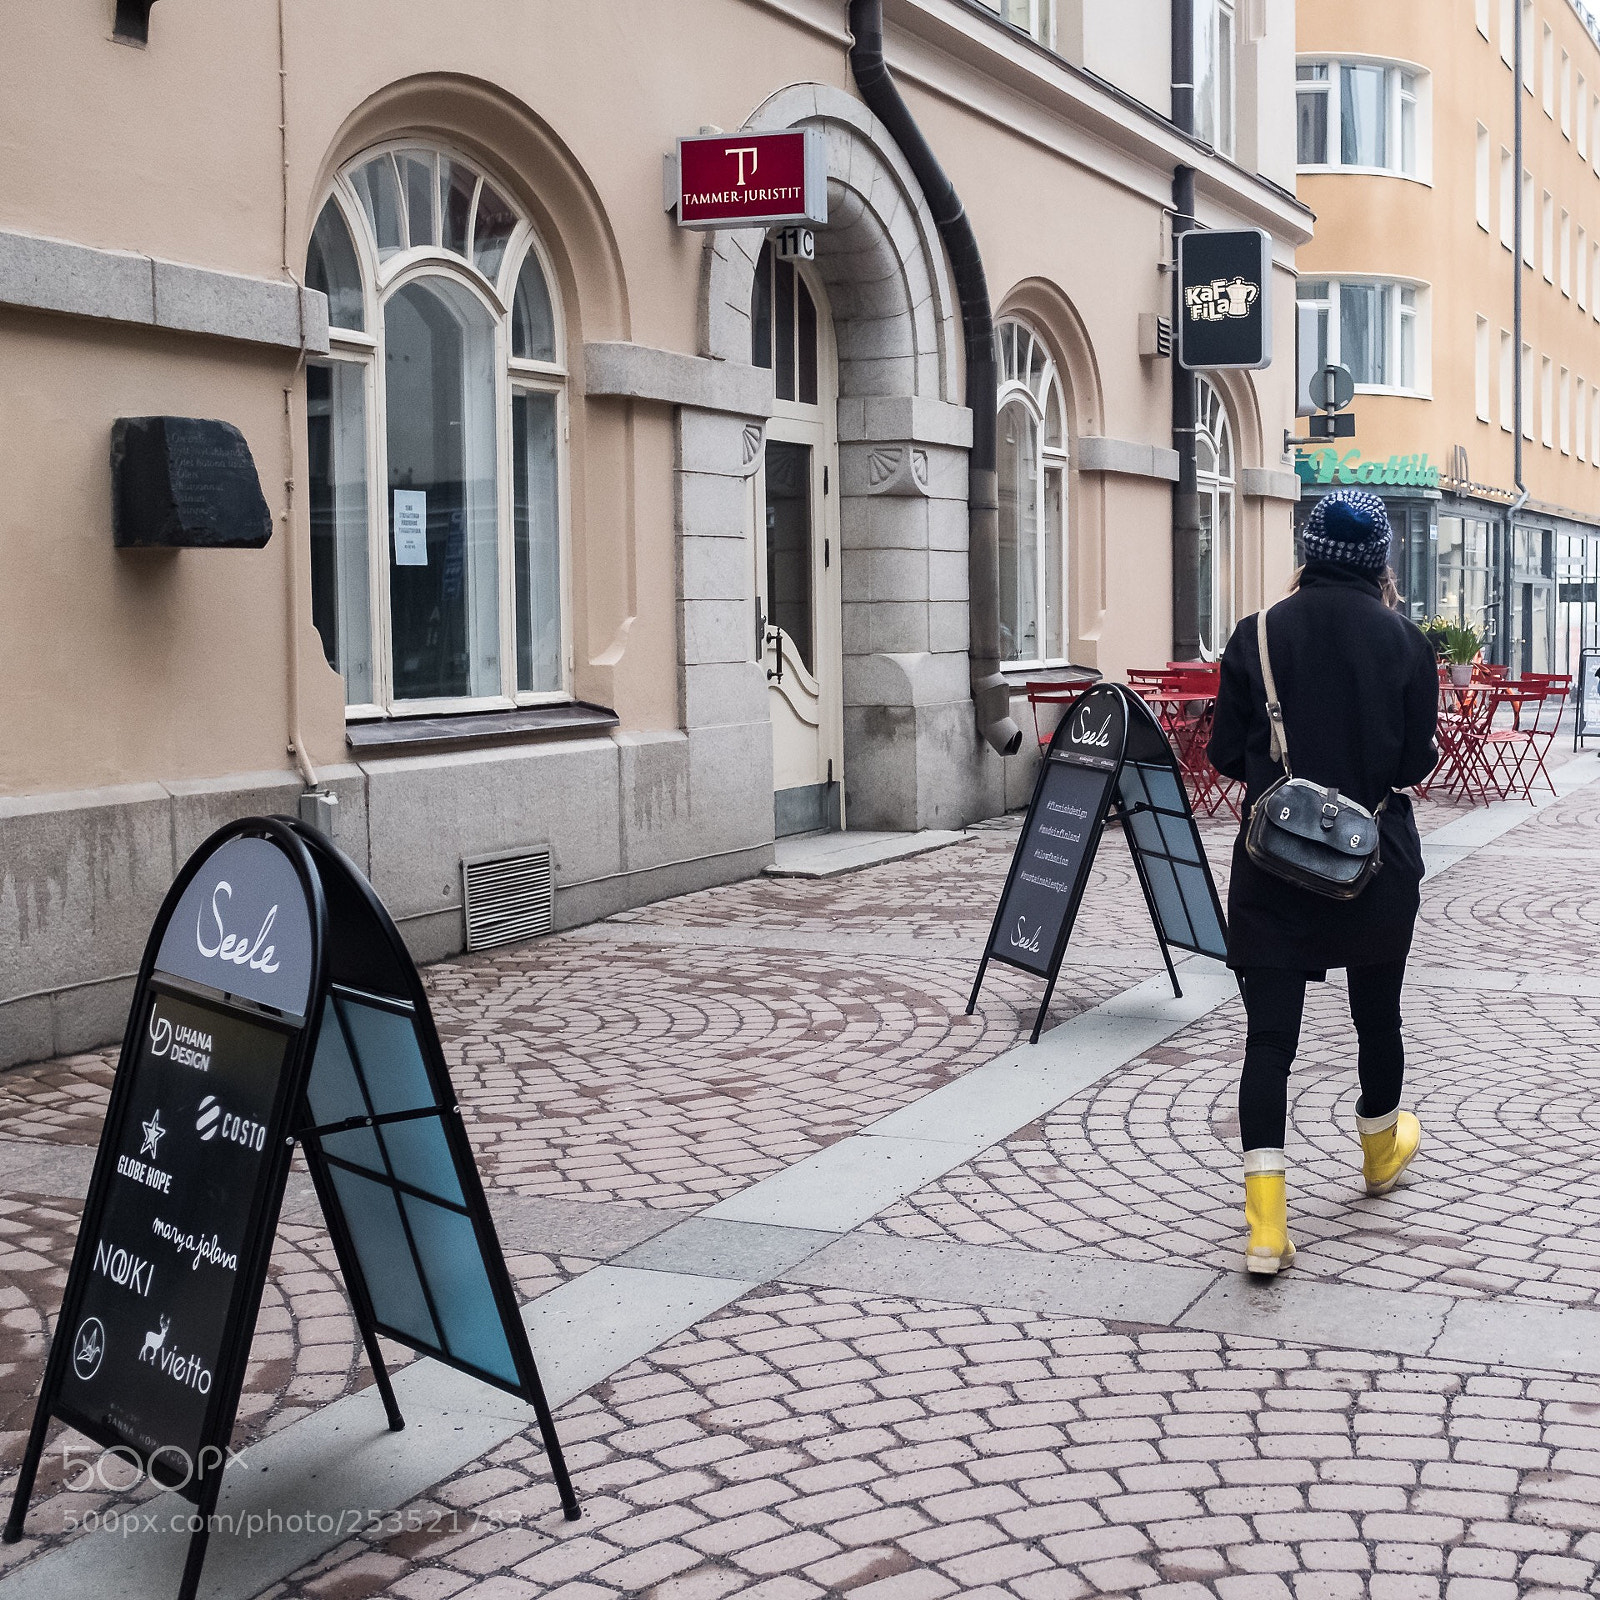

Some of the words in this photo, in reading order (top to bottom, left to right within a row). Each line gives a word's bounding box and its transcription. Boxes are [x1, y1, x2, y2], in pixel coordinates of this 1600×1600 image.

[682, 186, 802, 205] TAMMER-JURISTIT
[1071, 706, 1112, 747] Seele
[196, 881, 280, 974] Seele
[1011, 915, 1042, 953] Seele
[170, 1043, 211, 1072] DESIGN
[174, 1024, 213, 1052] UHANA
[221, 1112, 267, 1152] COSTO
[116, 1154, 147, 1184] GLOBE
[145, 1166, 173, 1195] HOPE
[161, 1345, 212, 1395] vietto
